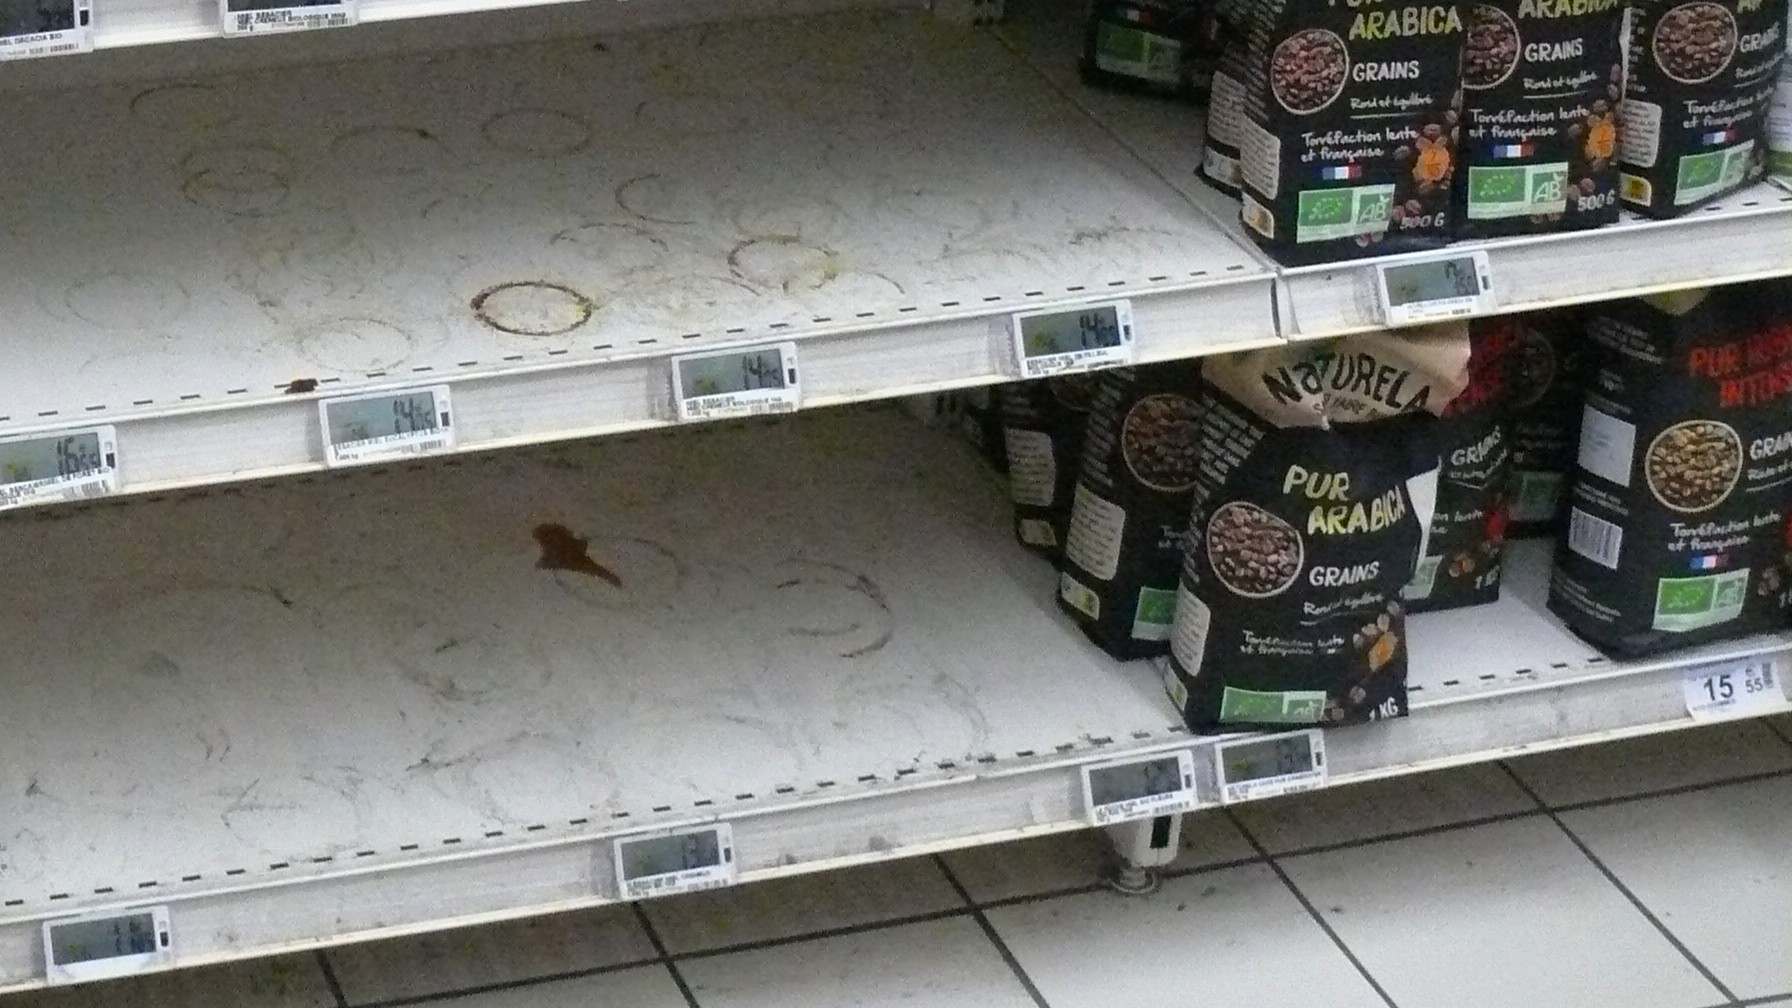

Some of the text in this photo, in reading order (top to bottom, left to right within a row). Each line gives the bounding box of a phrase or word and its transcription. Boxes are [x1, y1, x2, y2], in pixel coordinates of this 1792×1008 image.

[1348, 5, 1463, 41] ARABICA
[1524, 37, 1584, 62] GRAINS
[1352, 60, 1420, 82] GRAINS
[1350, 97, 1377, 109] Rond
[1379, 97, 1390, 107] et
[1469, 104, 1591, 124] Torréfaction lente
[1301, 126, 1419, 148] Torréfaction lente
[1468, 126, 1557, 142] et française
[1301, 147, 1384, 162] et française
[1534, 180, 1562, 202] AB
[1360, 203, 1387, 223] AB
[1577, 195, 1605, 212] 500
[1399, 212, 1445, 230] 500 G
[1283, 464, 1350, 501] PUR
[1307, 484, 1407, 535] ARABICA
[1309, 561, 1380, 587] GRAINS
[1704, 675, 1763, 701] 15 55
[1380, 696, 1399, 719] KG
